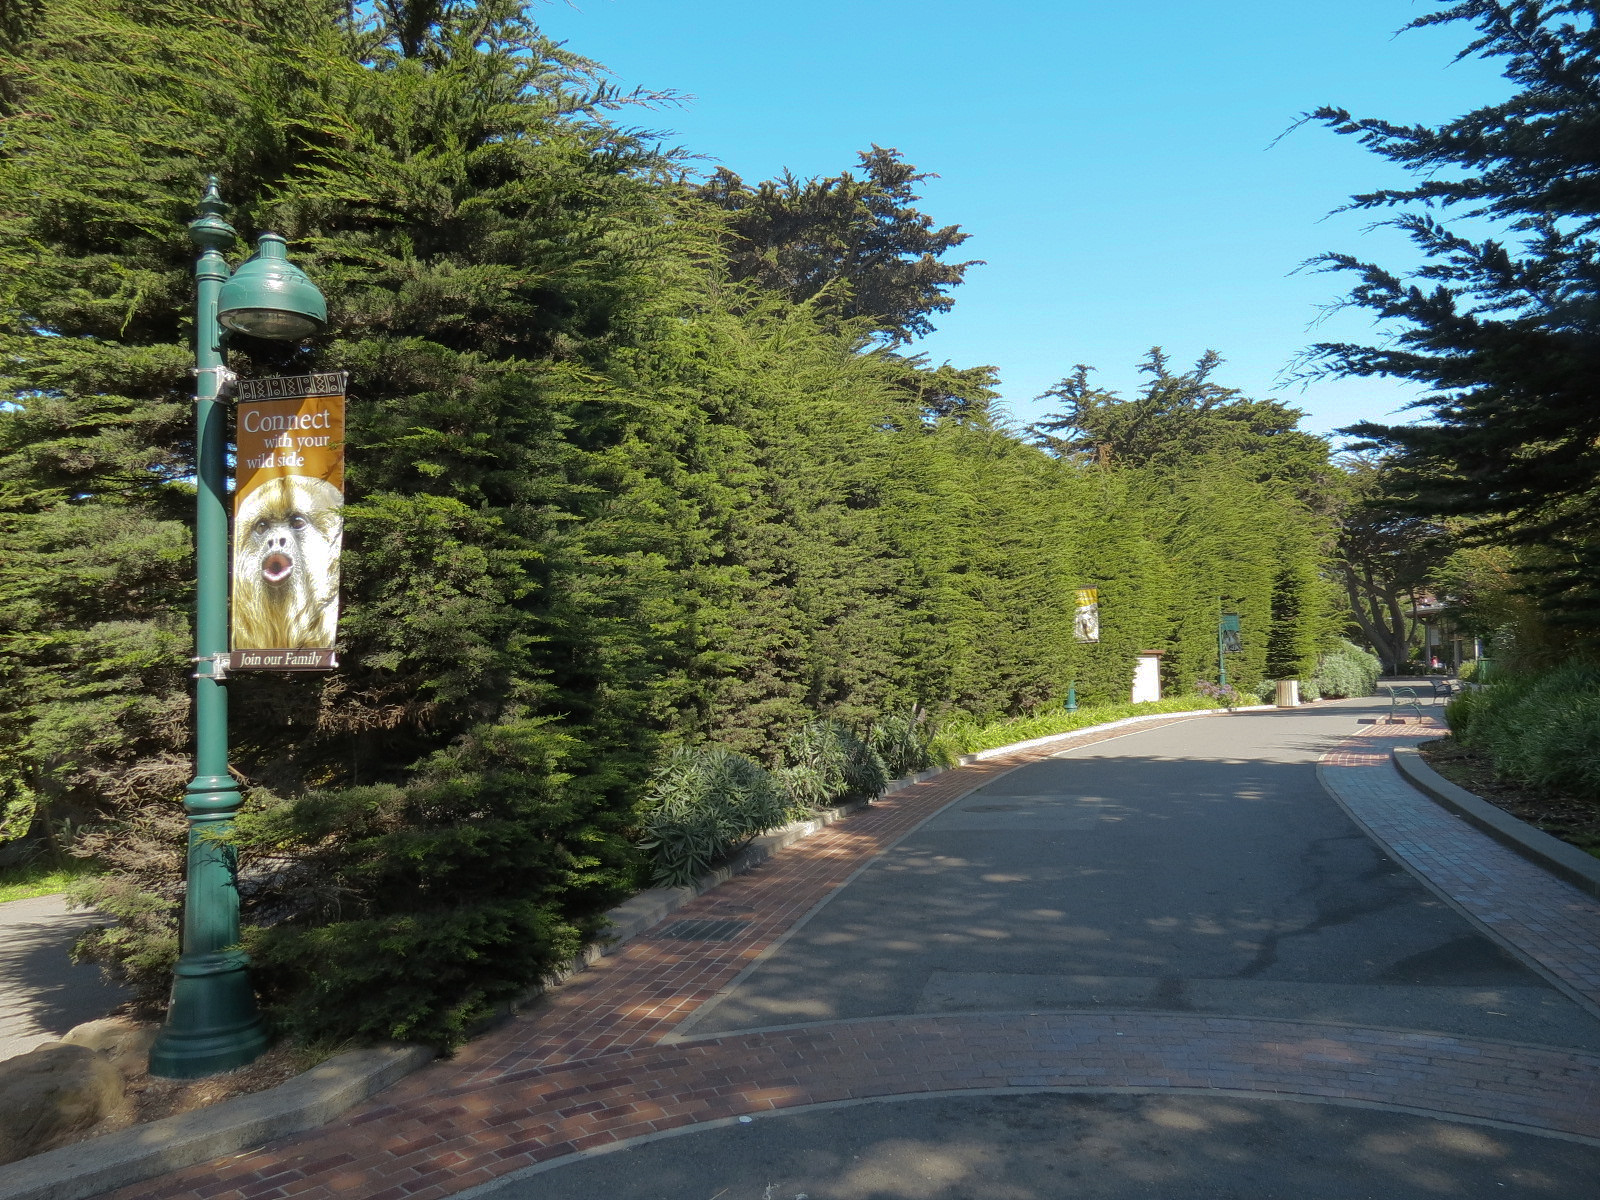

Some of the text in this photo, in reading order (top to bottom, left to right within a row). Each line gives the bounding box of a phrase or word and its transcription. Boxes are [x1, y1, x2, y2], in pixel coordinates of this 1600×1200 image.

[244, 409, 331, 432] Connect
[264, 432, 330, 452] with your
[246, 451, 305, 469] wild side
[240, 651, 322, 668] Join our Family
